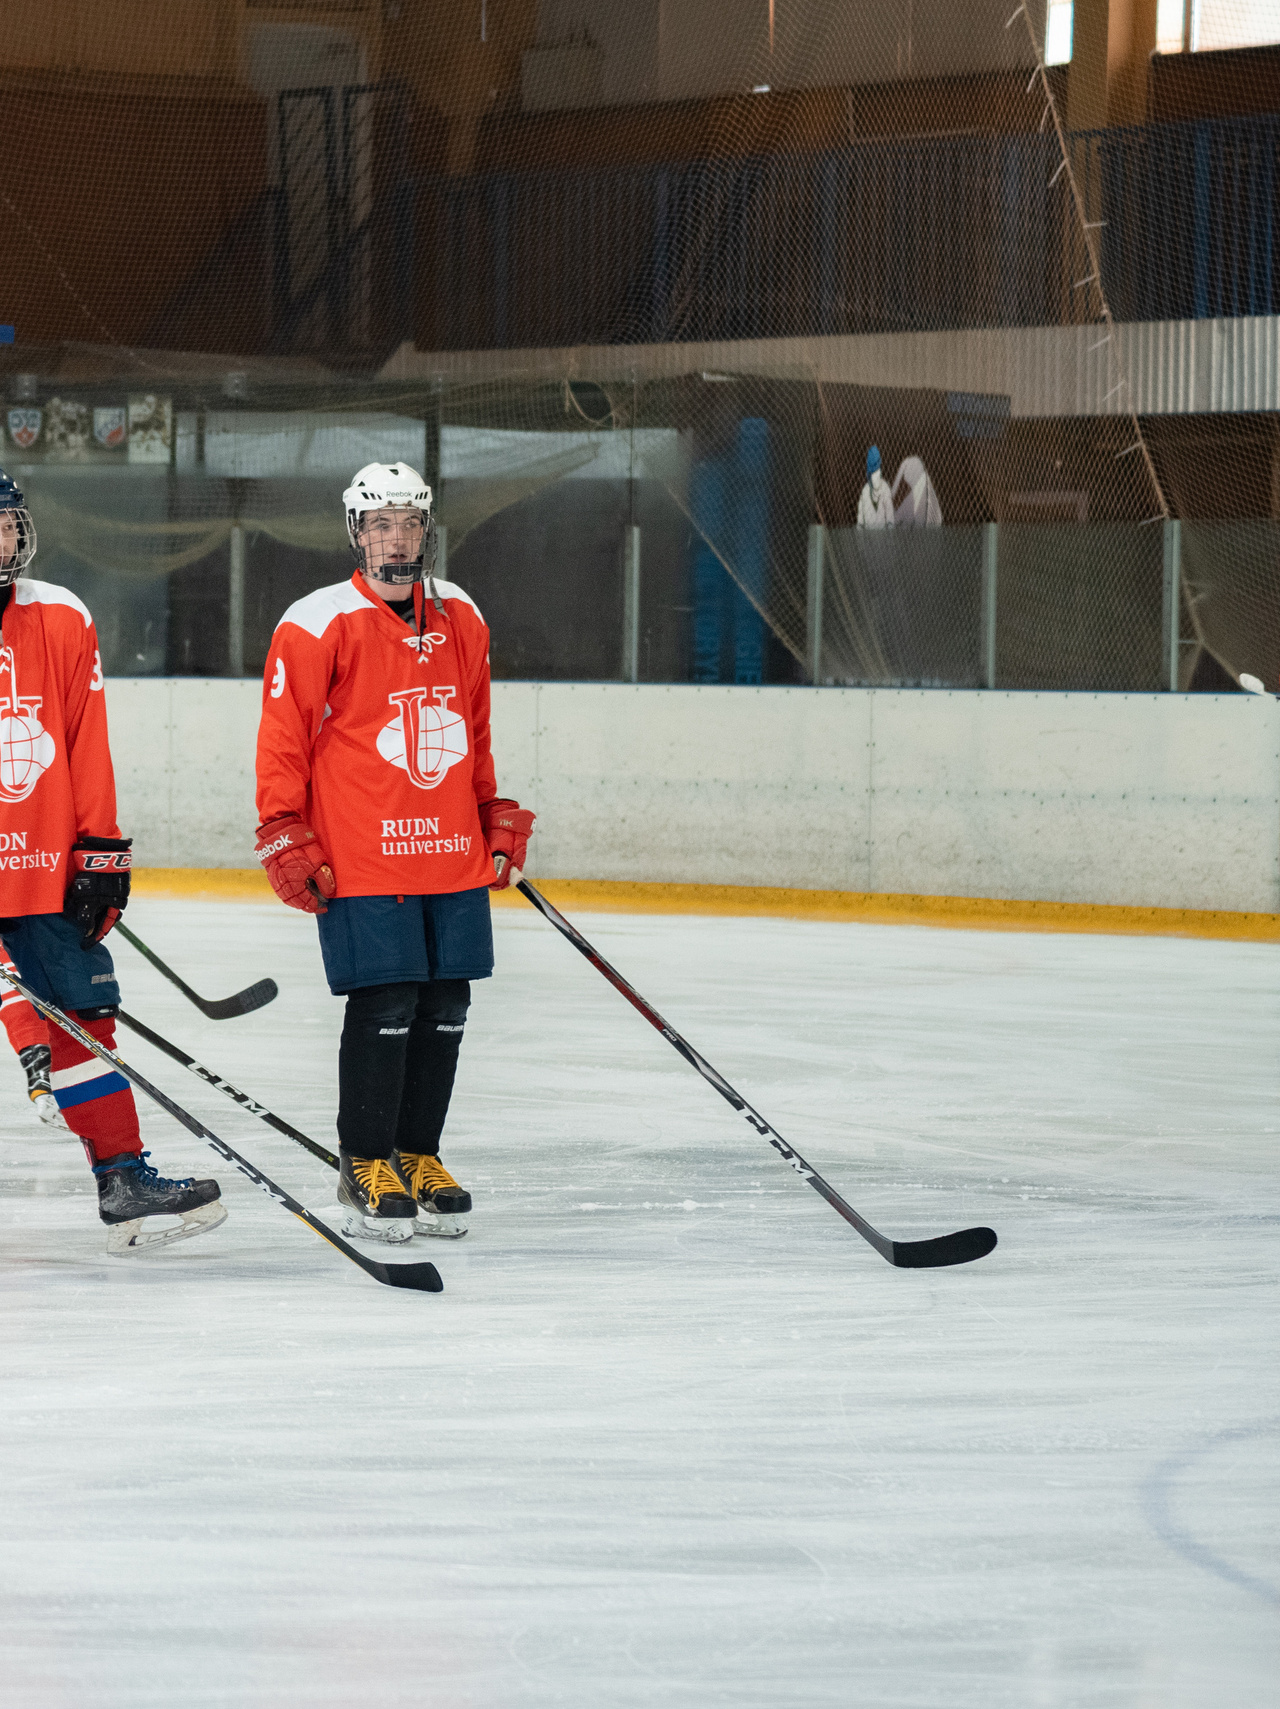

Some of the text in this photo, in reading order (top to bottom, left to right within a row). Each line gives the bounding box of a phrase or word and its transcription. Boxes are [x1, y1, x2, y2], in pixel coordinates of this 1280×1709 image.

[380, 817, 440, 838] RUDN
[380, 834, 472, 856] university
[379, 1027, 409, 1035] BAUER
[436, 1024, 464, 1032] BAUER
[187, 1060, 271, 1119] CCM
